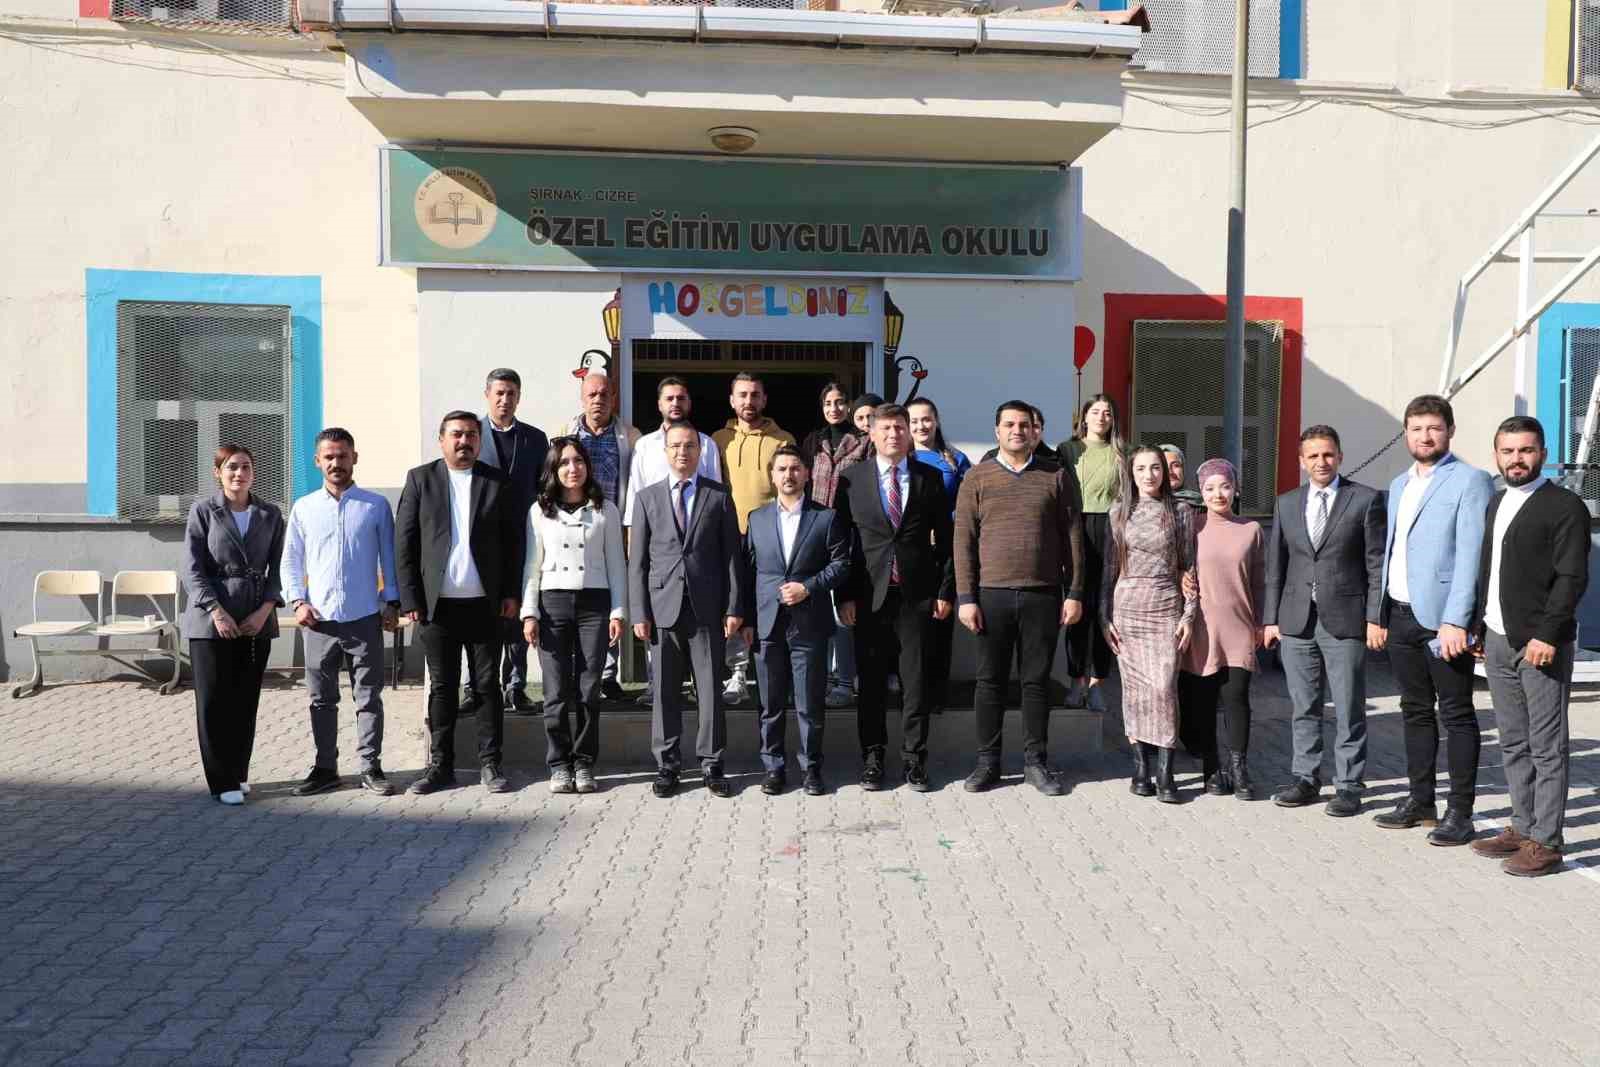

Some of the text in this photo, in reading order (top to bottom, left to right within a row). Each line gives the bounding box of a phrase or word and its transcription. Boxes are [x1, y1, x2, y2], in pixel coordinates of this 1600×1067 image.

[526, 208, 1049, 257] ÖZEL EĞİTİM UYGULAMA OKULU
